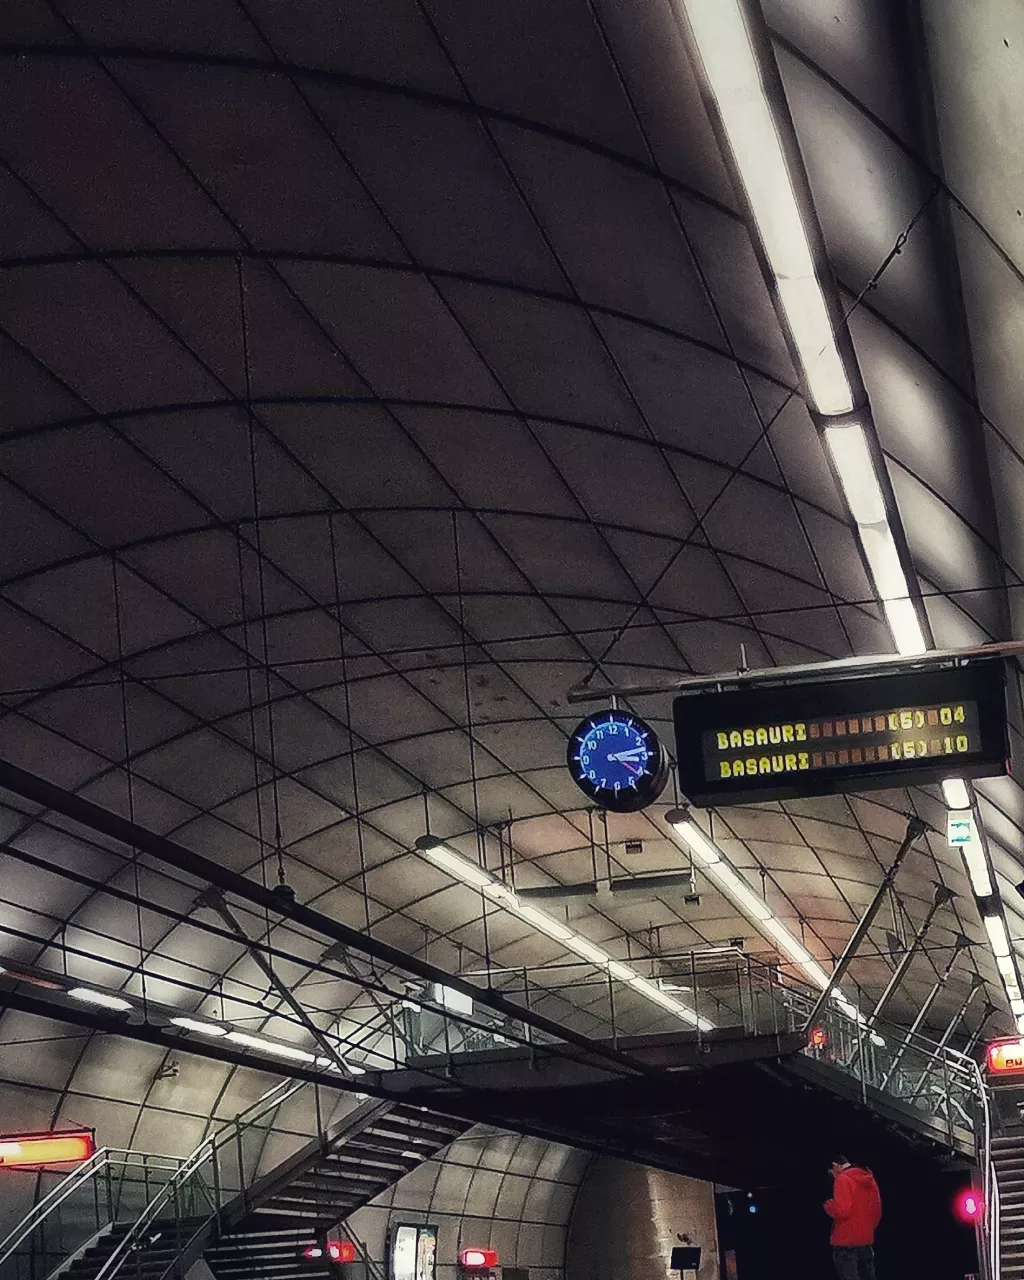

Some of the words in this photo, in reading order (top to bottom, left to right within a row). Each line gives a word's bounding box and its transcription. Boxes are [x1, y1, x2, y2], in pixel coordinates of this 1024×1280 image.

[608, 725, 618, 735] 12
[624, 728, 629, 737] 1
[717, 723, 807, 749] BASAURI
[940, 706, 965, 725] 04
[596, 731, 604, 740] 11
[587, 740, 597, 750] 10
[635, 736, 642, 746] 2
[720, 752, 809, 778] BASAURI
[944, 735, 968, 754] 10
[601, 778, 607, 788] 7
